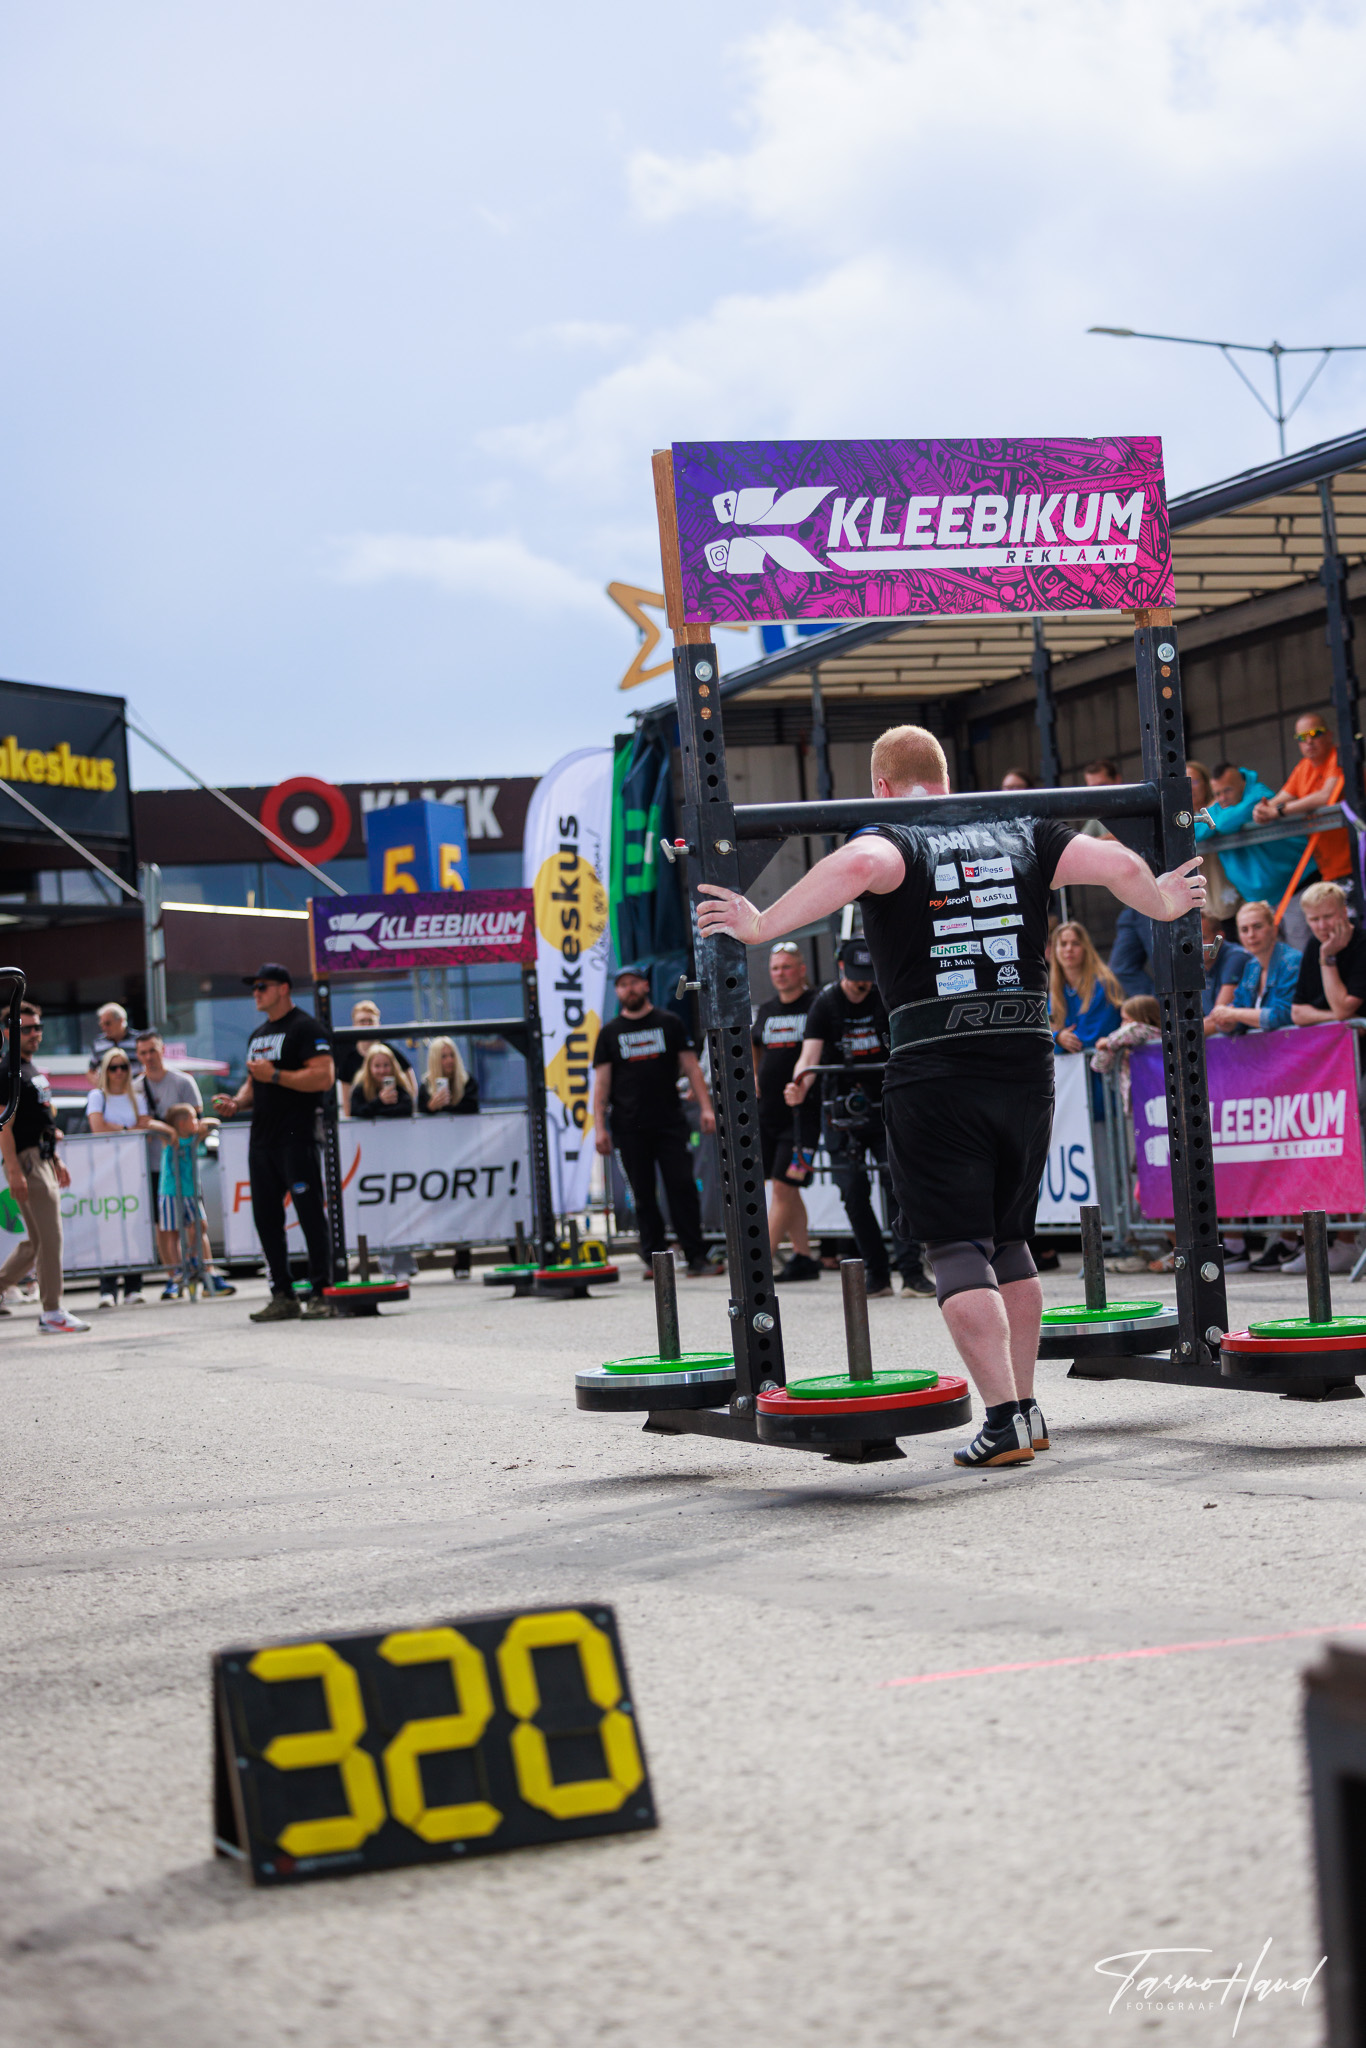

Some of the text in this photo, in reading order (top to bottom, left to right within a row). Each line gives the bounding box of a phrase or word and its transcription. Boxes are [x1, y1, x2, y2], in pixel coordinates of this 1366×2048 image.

[827, 491, 1145, 548] KLEEBIKUM
[1006, 546, 1129, 564] REKLAAM
[946, 895, 969, 906] SPORT
[378, 911, 526, 939] KLEEBIKUM
[945, 999, 1046, 1029] RDX
[1210, 1089, 1346, 1144] LEEBIKUM
[357, 1160, 521, 1207] SPORT!
[247, 1609, 645, 1858] 320
